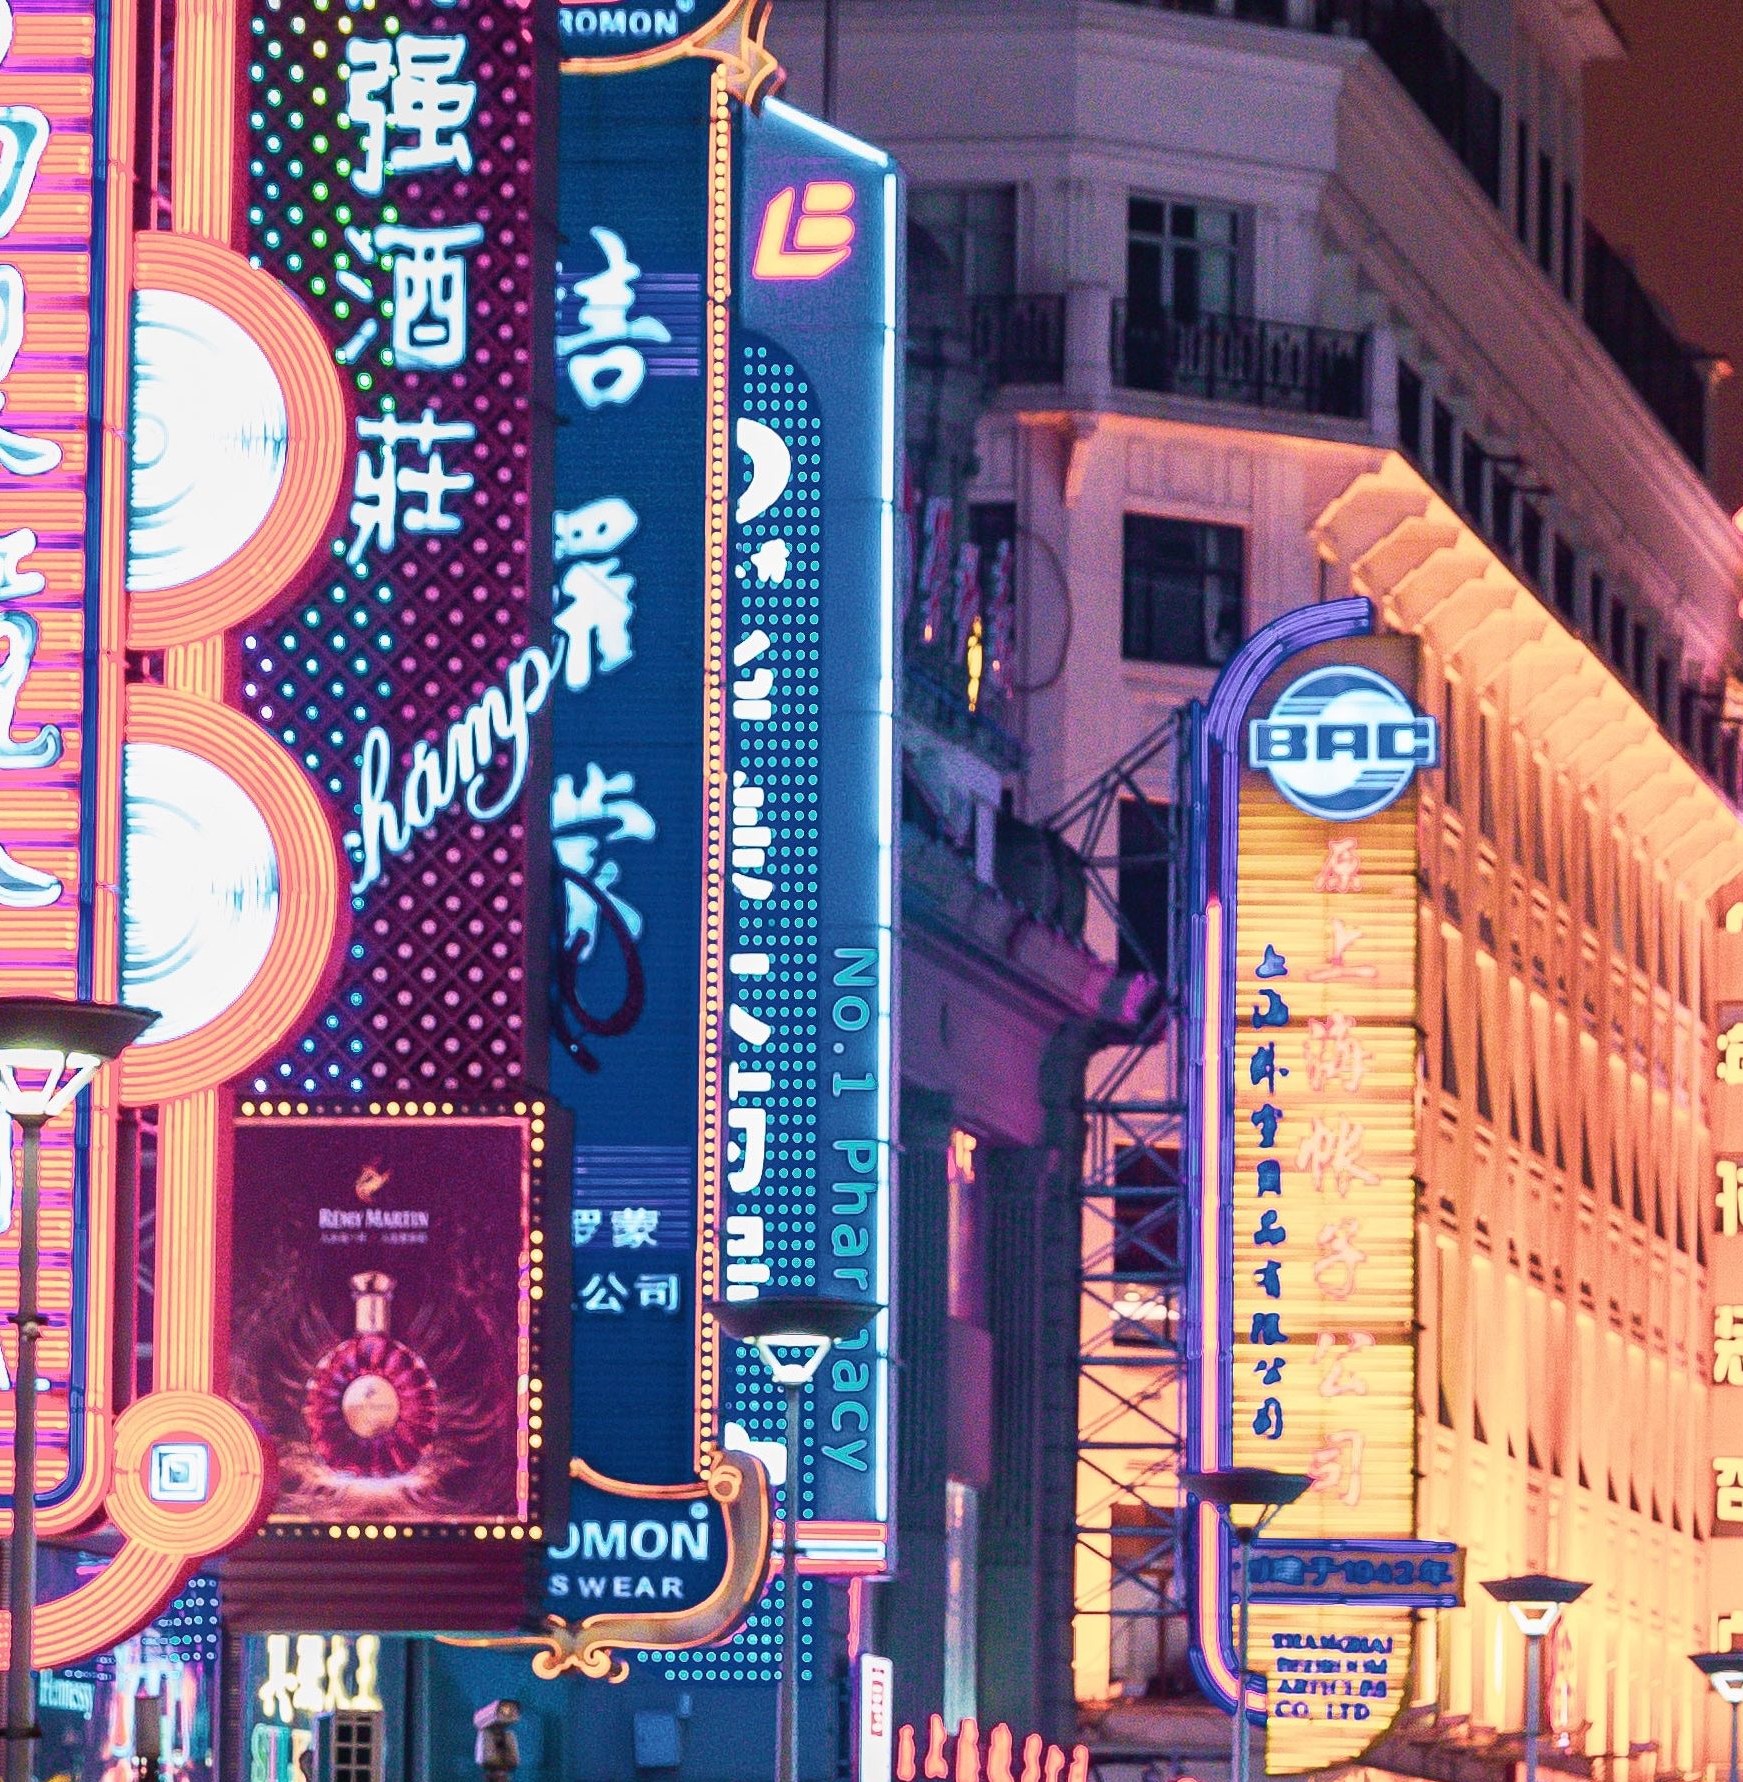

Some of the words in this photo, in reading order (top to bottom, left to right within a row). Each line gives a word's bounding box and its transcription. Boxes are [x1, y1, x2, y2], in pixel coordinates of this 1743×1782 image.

[1256, 724, 1429, 761] BAC
[832, 947, 879, 1098] No.1
[577, 1271, 680, 1313] 公司
[577, 1576, 685, 1599] WEAR
